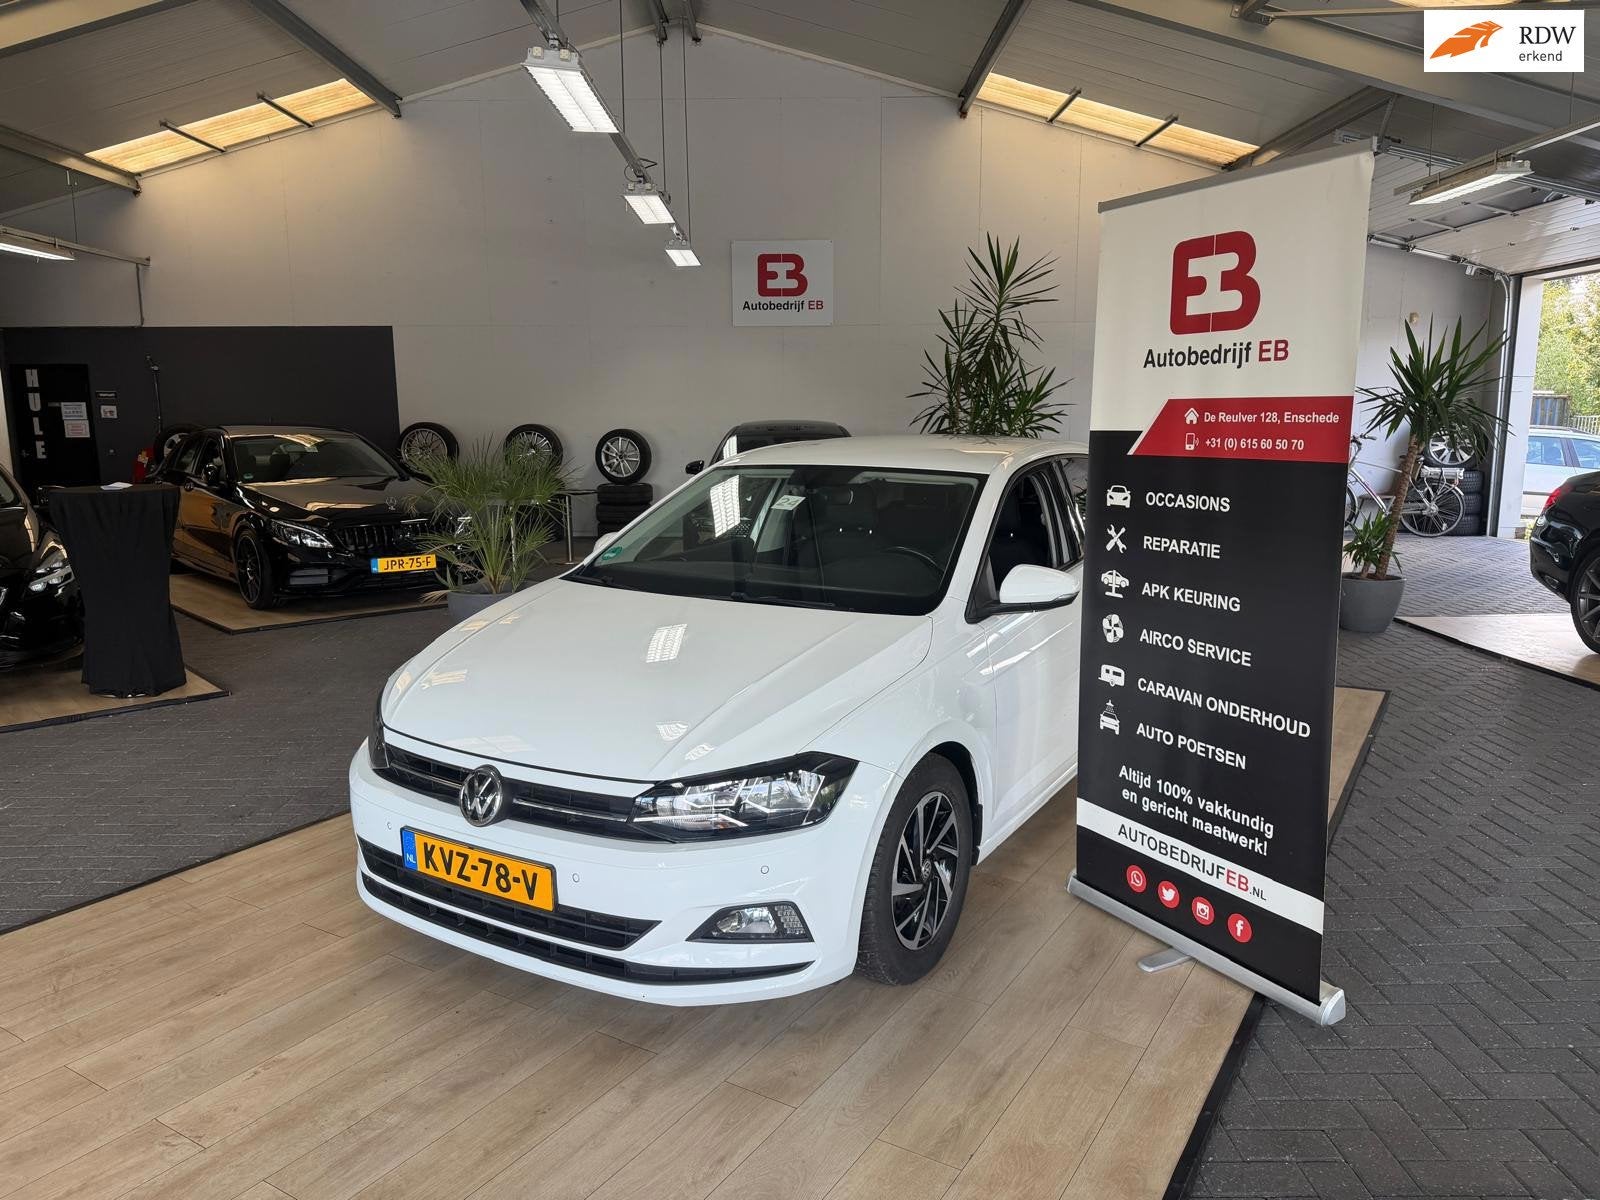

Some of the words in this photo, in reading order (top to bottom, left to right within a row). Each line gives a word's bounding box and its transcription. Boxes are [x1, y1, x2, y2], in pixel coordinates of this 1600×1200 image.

[757, 253, 808, 297] EB
[1169, 230, 1261, 335] EB
[743, 300, 805, 312] Autobedrijf
[808, 300, 824, 310] EB
[1143, 341, 1252, 369] Autobedrijf
[1258, 339, 1289, 362] EB
[1204, 412, 1216, 423] De
[1218, 412, 1257, 423] Reulver
[1260, 412, 1281, 425] 128,
[1283, 411, 1339, 424] Enschede
[1205, 438, 1221, 449] +31
[1224, 438, 1238, 450] (0)
[1240, 438, 1258, 449] 615
[1260, 439, 1273, 450] 60
[1275, 439, 1288, 450] 50
[1291, 439, 1304, 451] 70
[1145, 491, 1231, 513] OCCASIONS
[383, 556, 431, 571] JPR-75-F
[1143, 535, 1221, 559] REPARATIE
[1141, 582, 1170, 600] APK
[1174, 587, 1241, 612] KEURING
[1139, 628, 1184, 651] AIRCO
[1187, 638, 1252, 667] SERVICE
[1137, 677, 1202, 708] CARAVAN
[1206, 696, 1311, 738] ONDERHOUD
[1136, 722, 1174, 746] AUTO
[1177, 734, 1247, 770] POETSEN
[1118, 764, 1151, 789] Altijd
[1157, 778, 1193, 805] 100%
[1197, 796, 1274, 839] vakkundig
[1121, 788, 1137, 805] en
[1141, 796, 1189, 824] gericht
[1192, 816, 1268, 857] maatwerk!
[406, 852, 417, 864] NL
[423, 841, 538, 901] KVZ-78-V
[1117, 823, 1267, 901] AUTOBEDRIJFEB.NL
